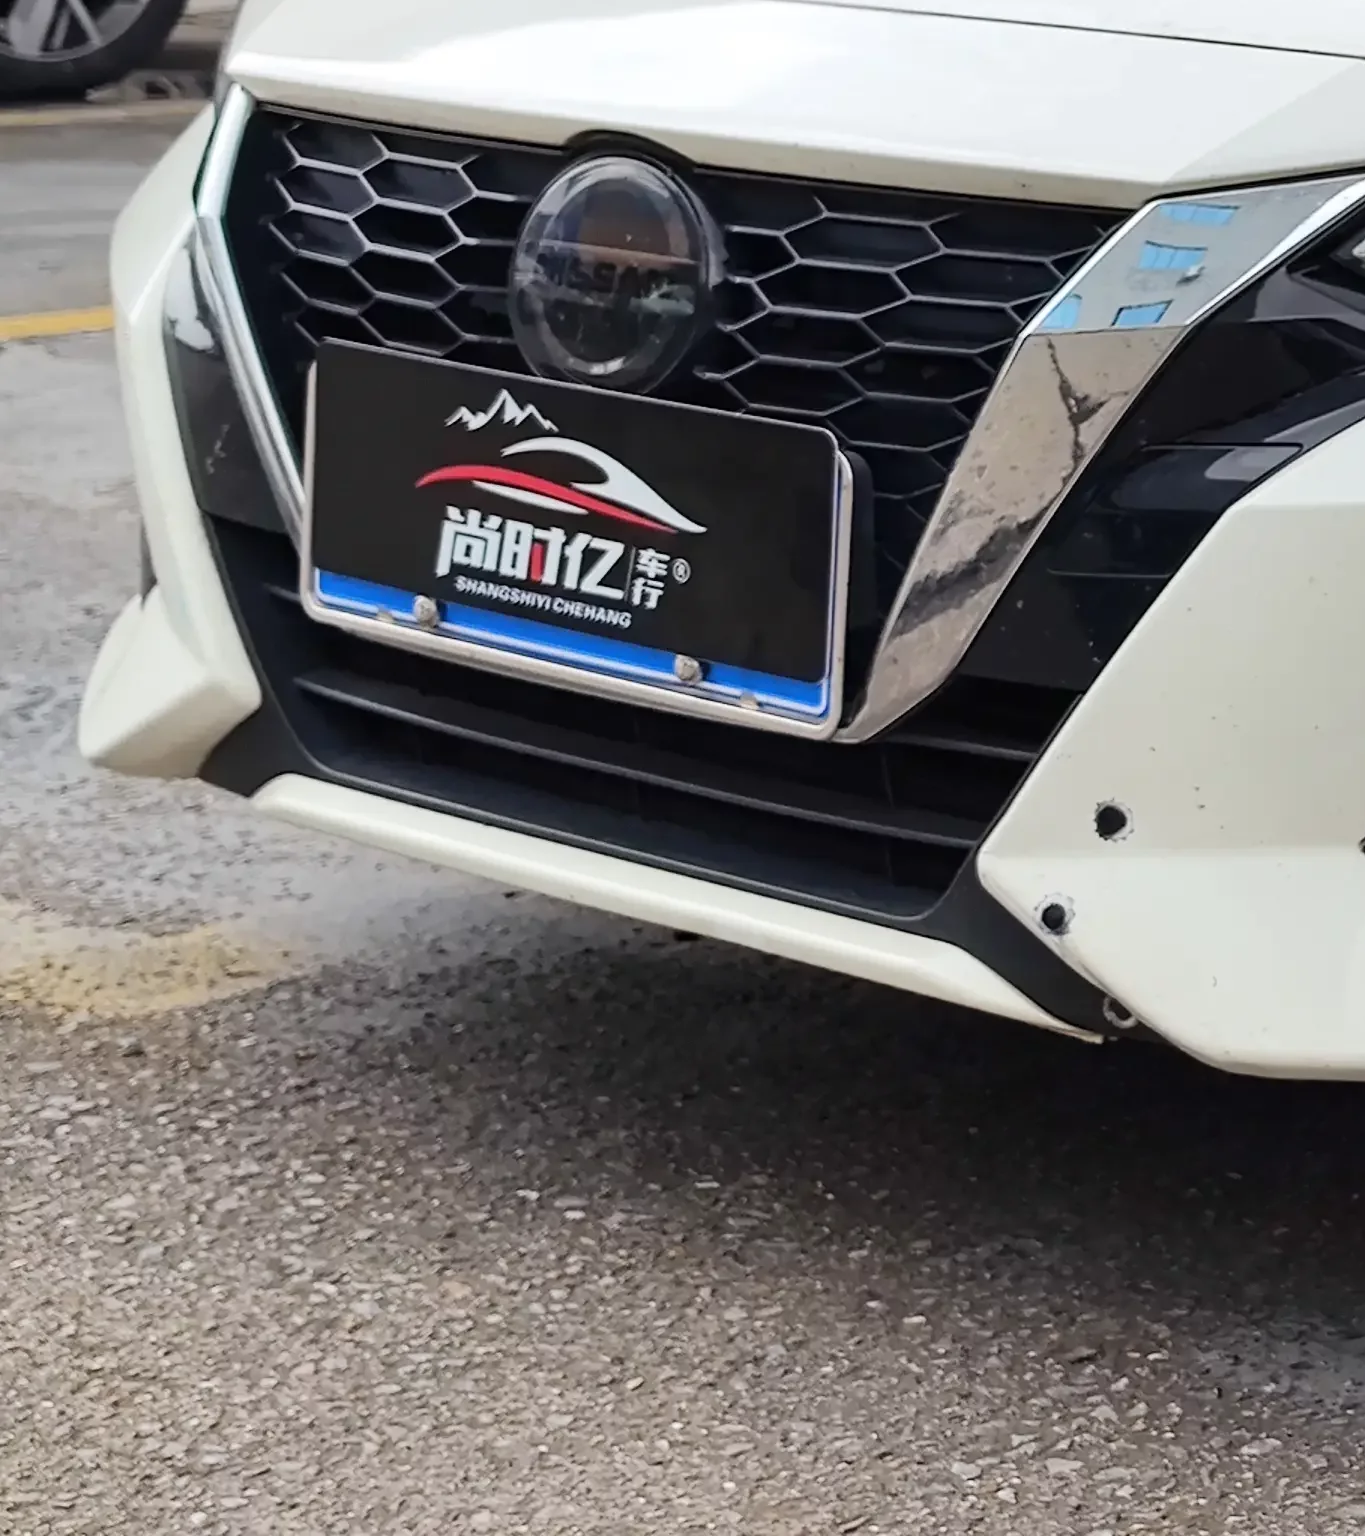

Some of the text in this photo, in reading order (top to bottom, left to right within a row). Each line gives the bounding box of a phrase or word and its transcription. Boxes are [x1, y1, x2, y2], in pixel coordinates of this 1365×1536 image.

[435, 505, 625, 600] 尚时亿
[455, 575, 632, 630] SHANGSHIYI CHEHANG
